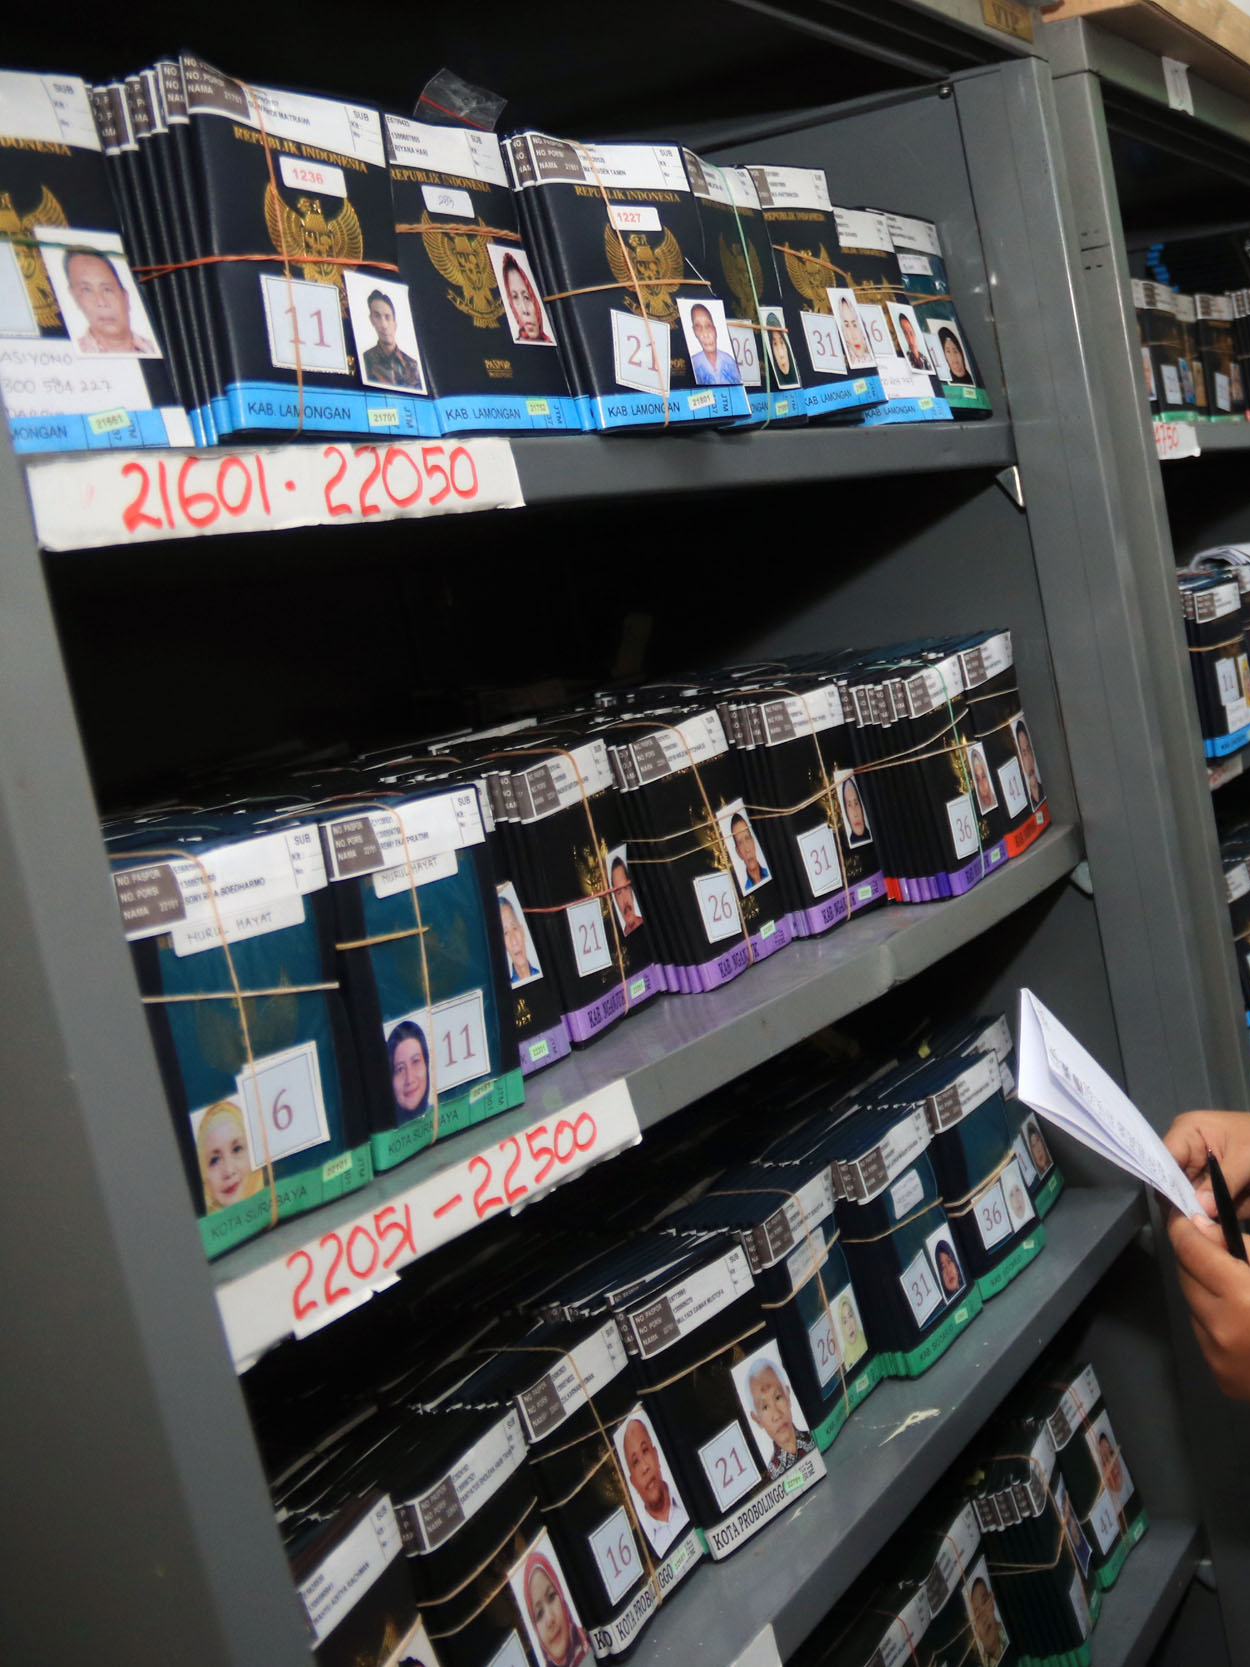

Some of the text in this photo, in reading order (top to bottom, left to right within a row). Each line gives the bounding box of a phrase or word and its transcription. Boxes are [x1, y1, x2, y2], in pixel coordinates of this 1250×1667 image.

[188, 84, 214, 96] NAMA
[301, 145, 369, 174] INDONESIA
[291, 167, 325, 186] 1236
[628, 190, 681, 203] INDONESIA
[616, 211, 642, 223] 1227
[284, 305, 332, 348] 11
[626, 335, 659, 372] 21
[733, 336, 755, 366] 26
[812, 329, 838, 358] 31
[247, 401, 352, 420] KAB. LAMONGAN
[473, 407, 521, 420] LAMONGAN
[631, 401, 681, 416] LAMONGAN
[121, 445, 479, 532] 21601 22050
[457, 796, 472, 807] SUB
[293, 833, 311, 846] SUB
[955, 815, 973, 843] 36
[809, 845, 833, 876] 31
[123, 907, 149, 920] NAMA
[708, 891, 733, 923] 26
[577, 921, 602, 956] 21
[442, 1022, 477, 1068] 11
[272, 1088, 294, 1131] 6
[412, 1109, 460, 1143] SURAAYA
[245, 1185, 308, 1225] SURBAYA
[286, 1203, 418, 1322] 22051
[468, 1111, 598, 1219] 22500
[982, 1202, 1001, 1232] 36
[911, 1272, 932, 1309] 31
[816, 1330, 836, 1367] 26
[714, 1447, 747, 1489] 21
[712, 1521, 740, 1551] KOTA
[606, 1532, 632, 1579] 16
[615, 1563, 674, 1641] KOTA PROBGGO
